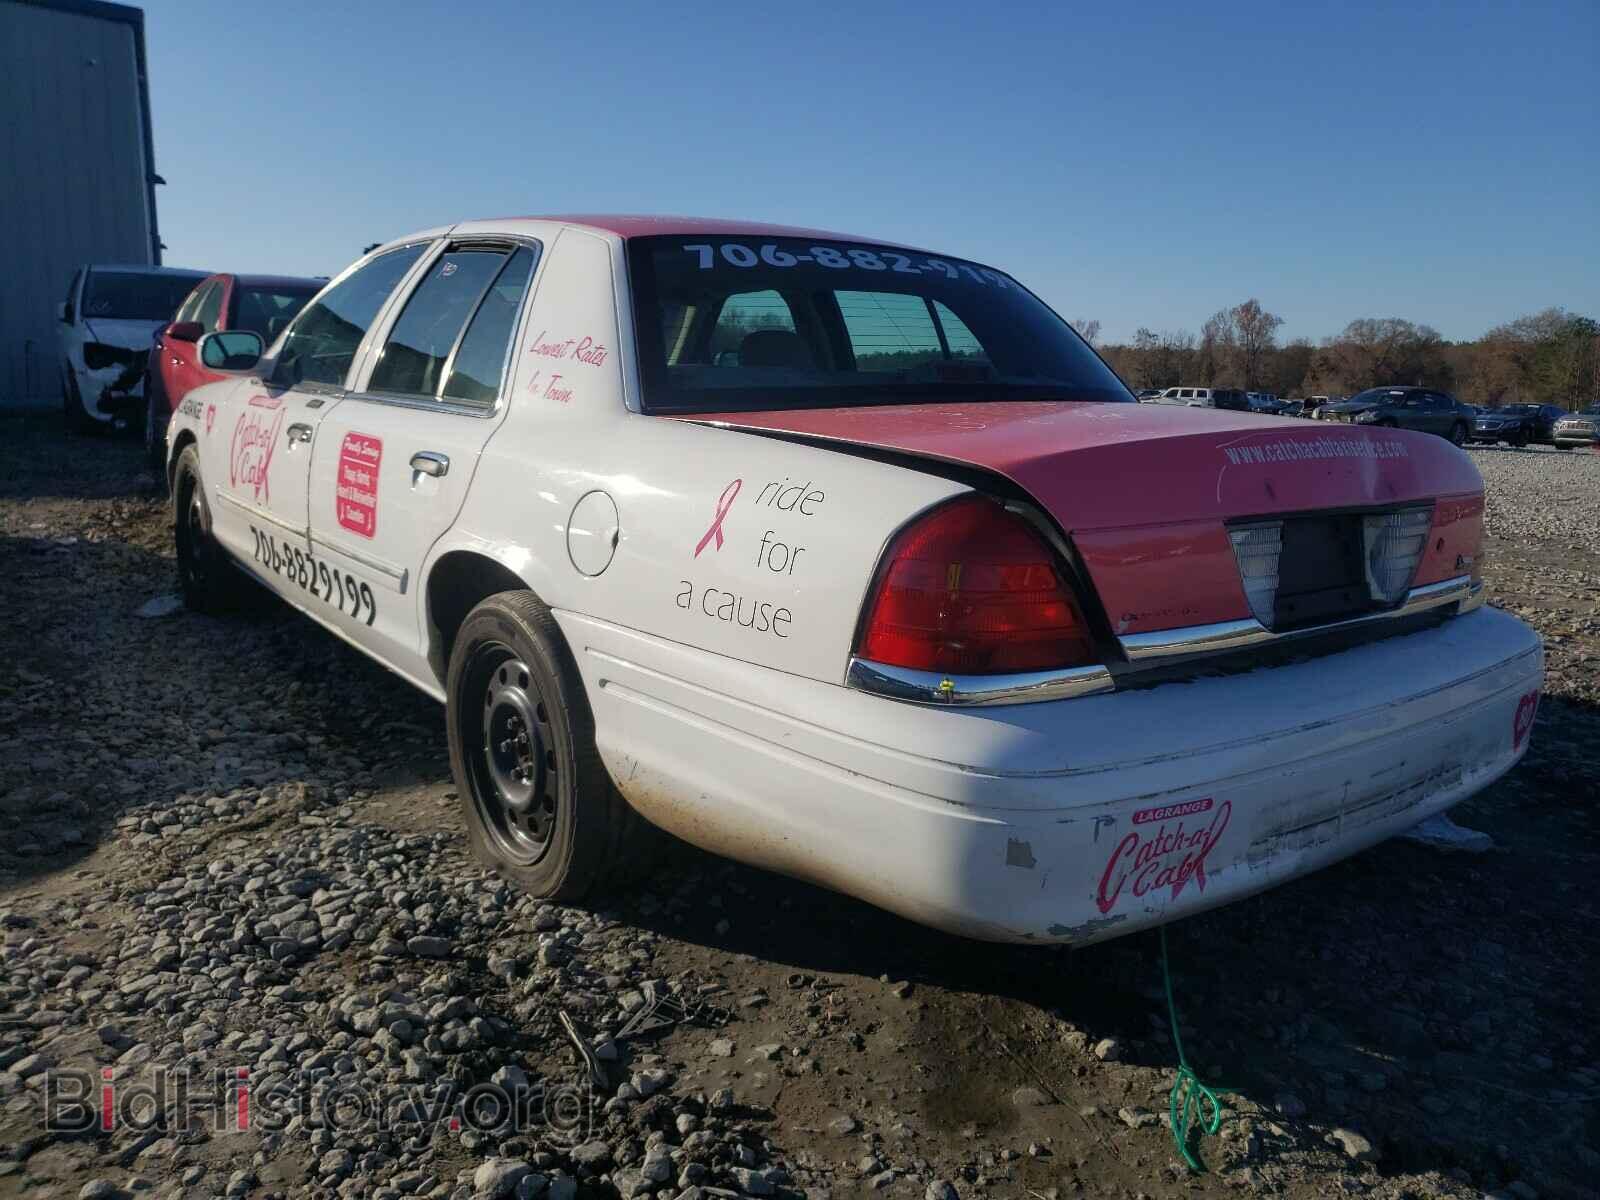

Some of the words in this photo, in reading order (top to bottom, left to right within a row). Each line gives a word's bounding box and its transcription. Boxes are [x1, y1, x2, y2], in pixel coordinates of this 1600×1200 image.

[530, 330, 576, 359] Lowest
[570, 336, 608, 367] Rates
[544, 374, 573, 403] Town
[755, 476, 825, 517] ride
[757, 530, 806, 576] for
[249, 524, 377, 627] 706-8829199
[676, 579, 694, 610] a
[702, 587, 793, 638] cause
[1138, 800, 1210, 823] LAGRANGE
